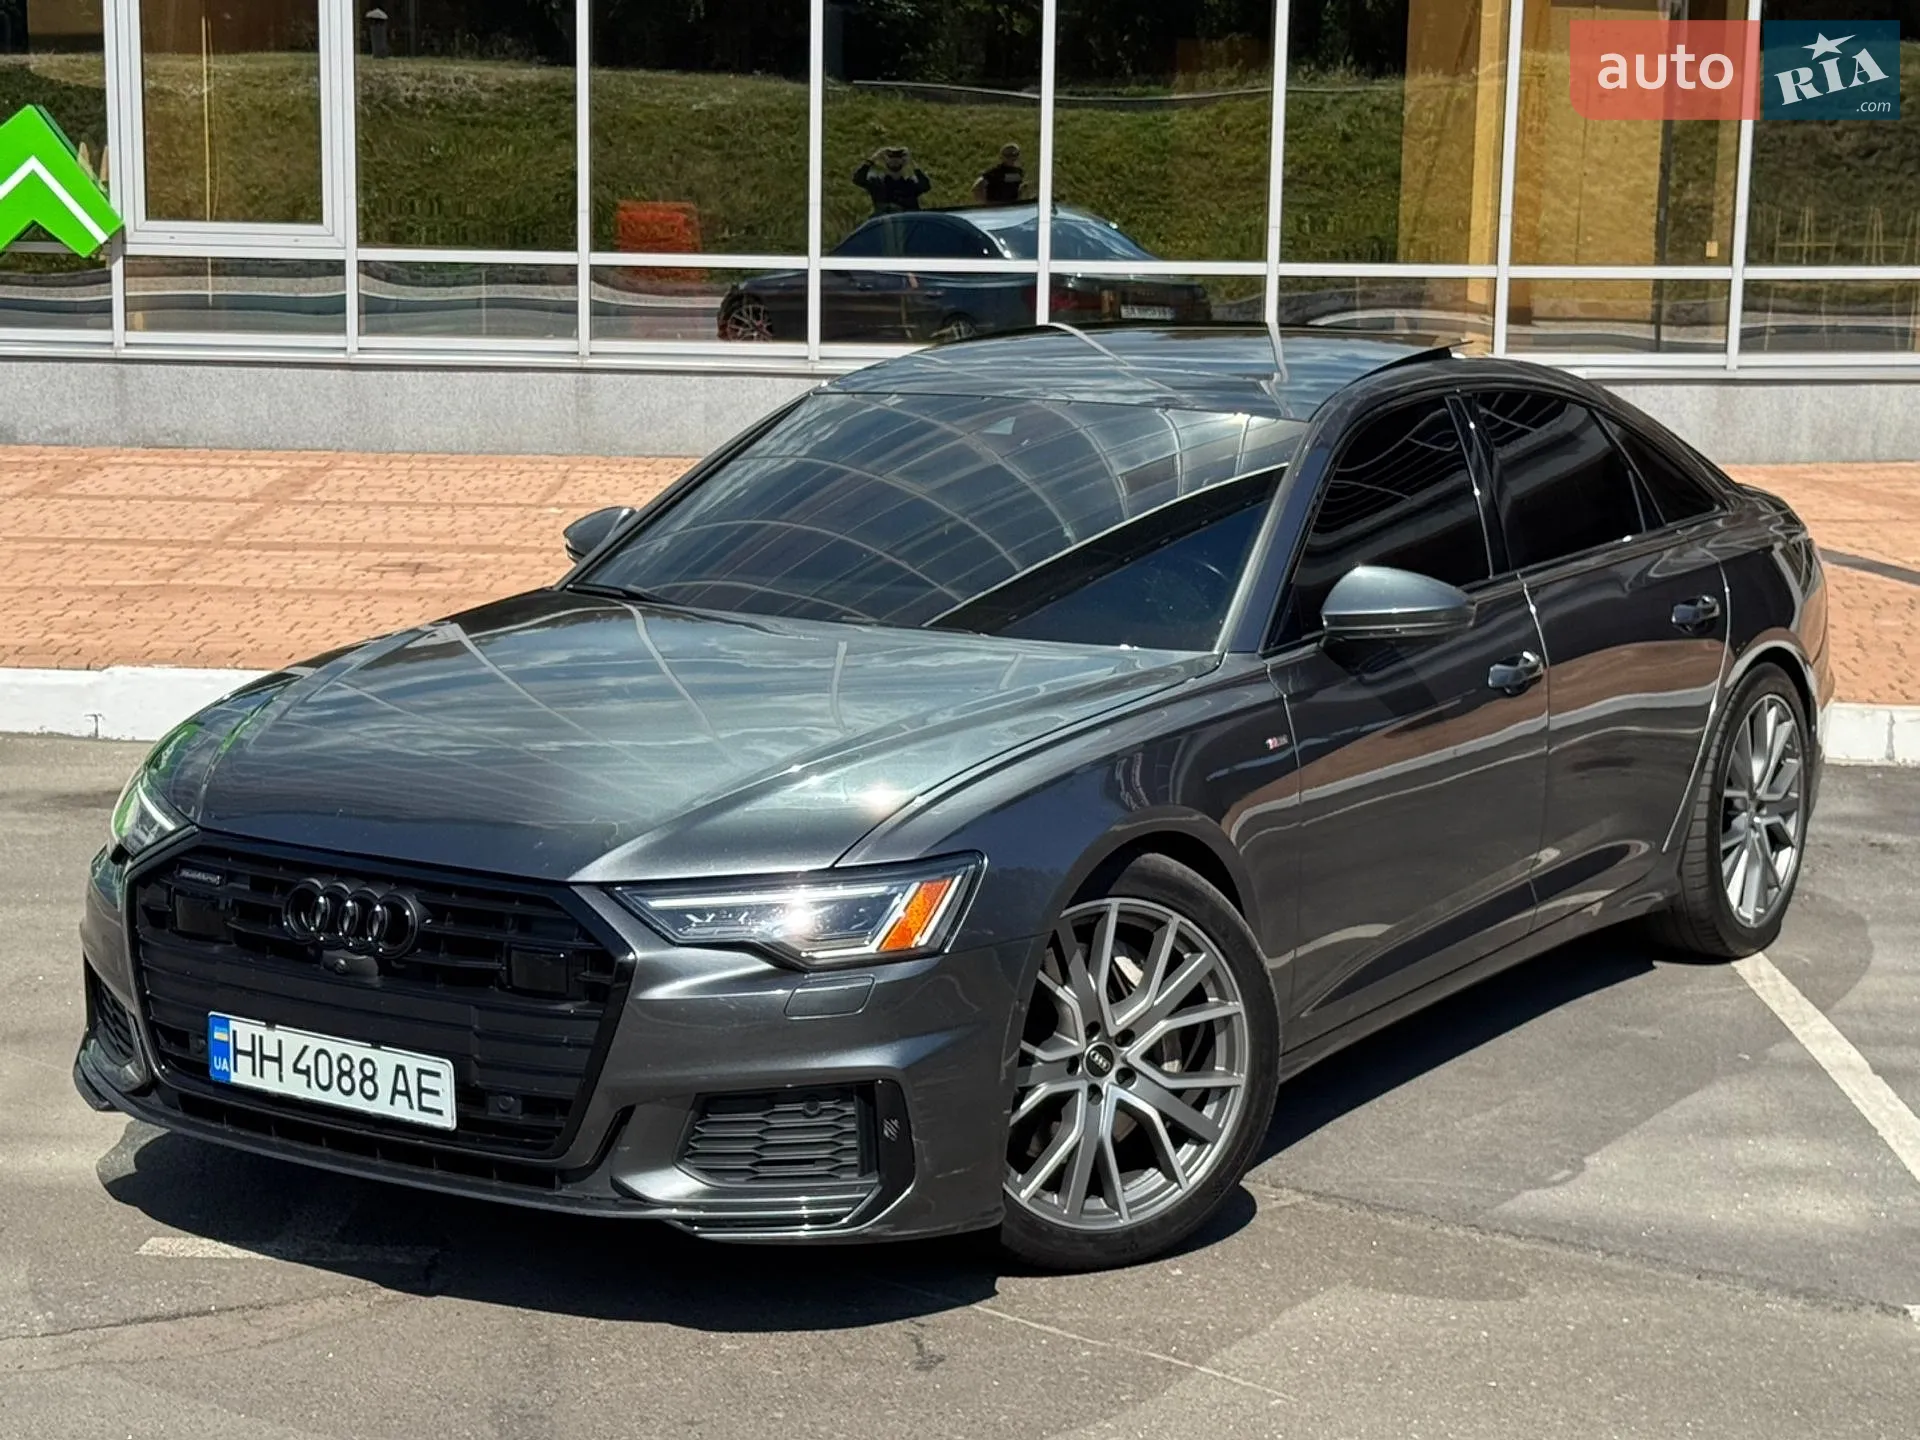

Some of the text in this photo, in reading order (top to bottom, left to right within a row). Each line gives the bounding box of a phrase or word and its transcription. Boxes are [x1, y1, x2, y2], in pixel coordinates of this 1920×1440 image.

[213, 1055, 230, 1072] UA
[232, 1029, 444, 1116] HH 4088 AE
